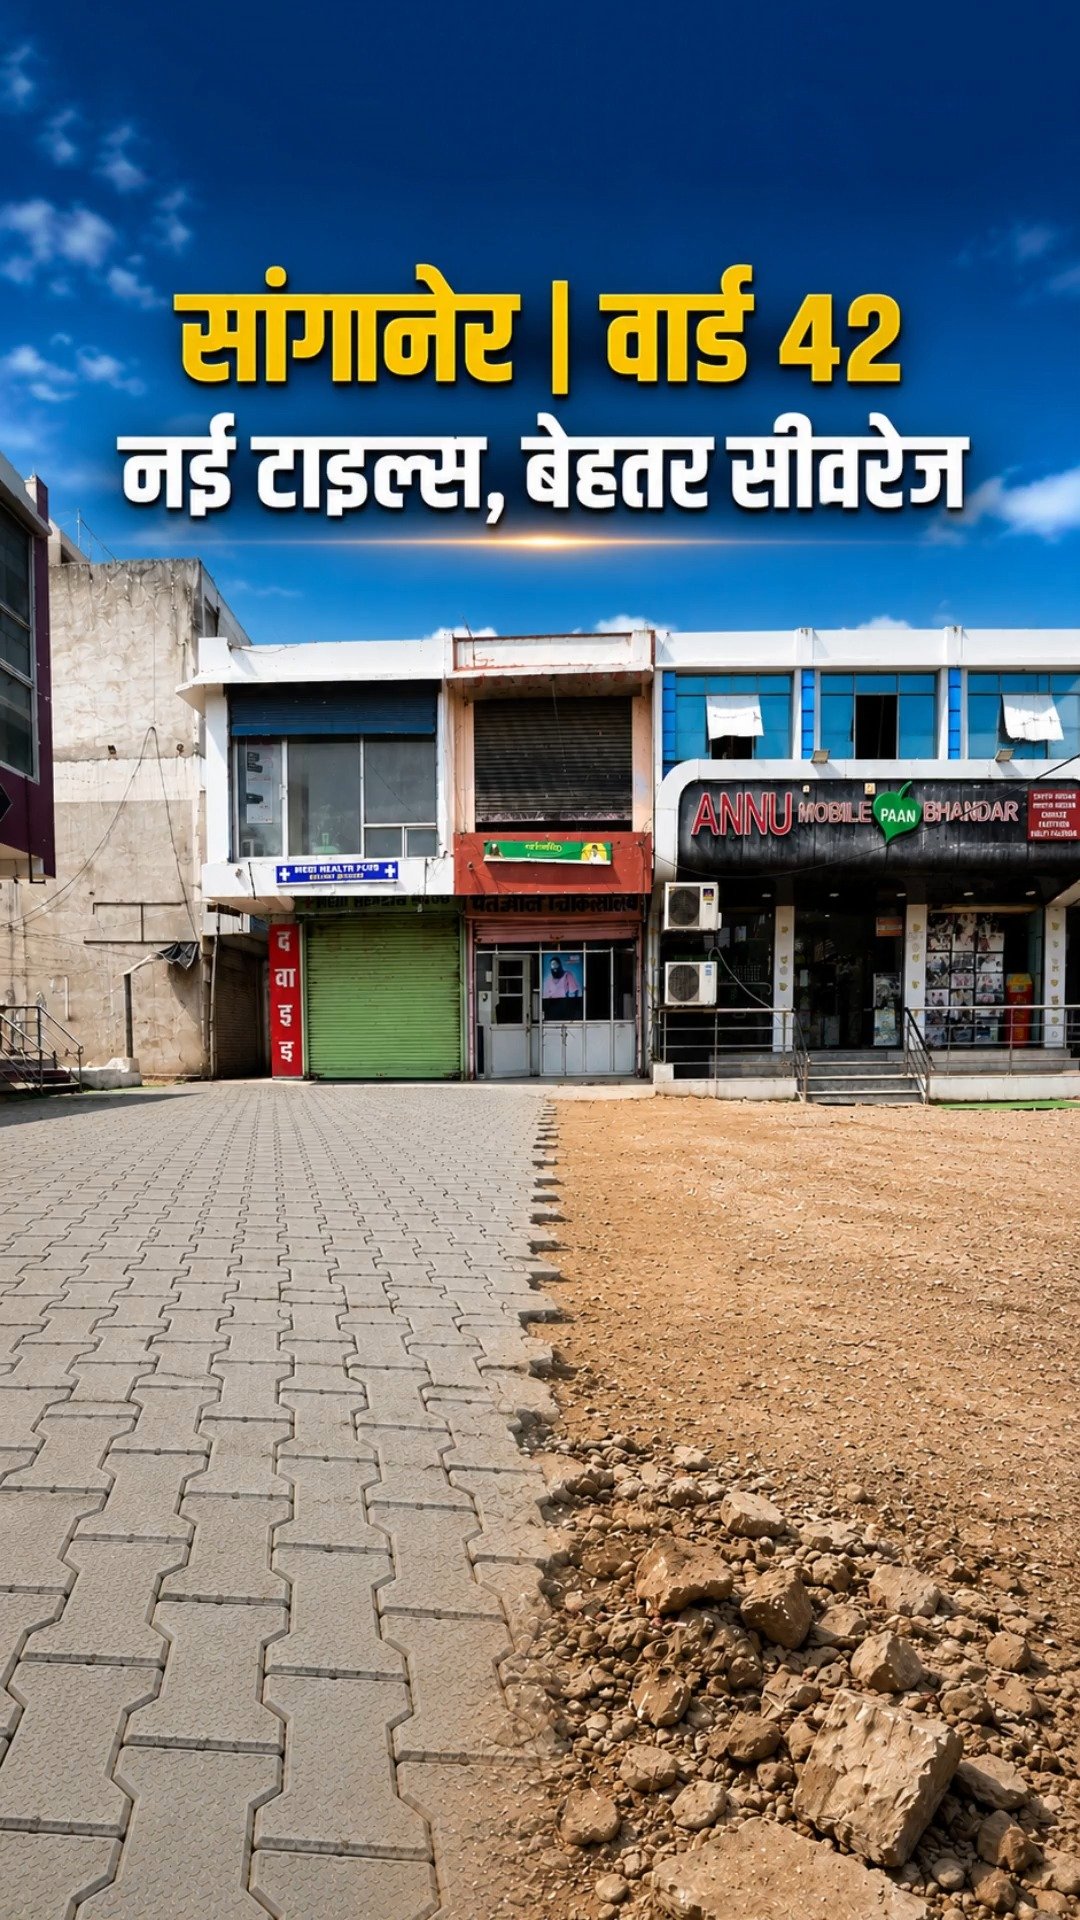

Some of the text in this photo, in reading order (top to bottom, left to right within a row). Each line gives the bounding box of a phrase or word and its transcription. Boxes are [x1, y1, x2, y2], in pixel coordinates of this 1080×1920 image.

[691, 791, 1019, 836] ANNU MOBILE PAAN BHANDAR
